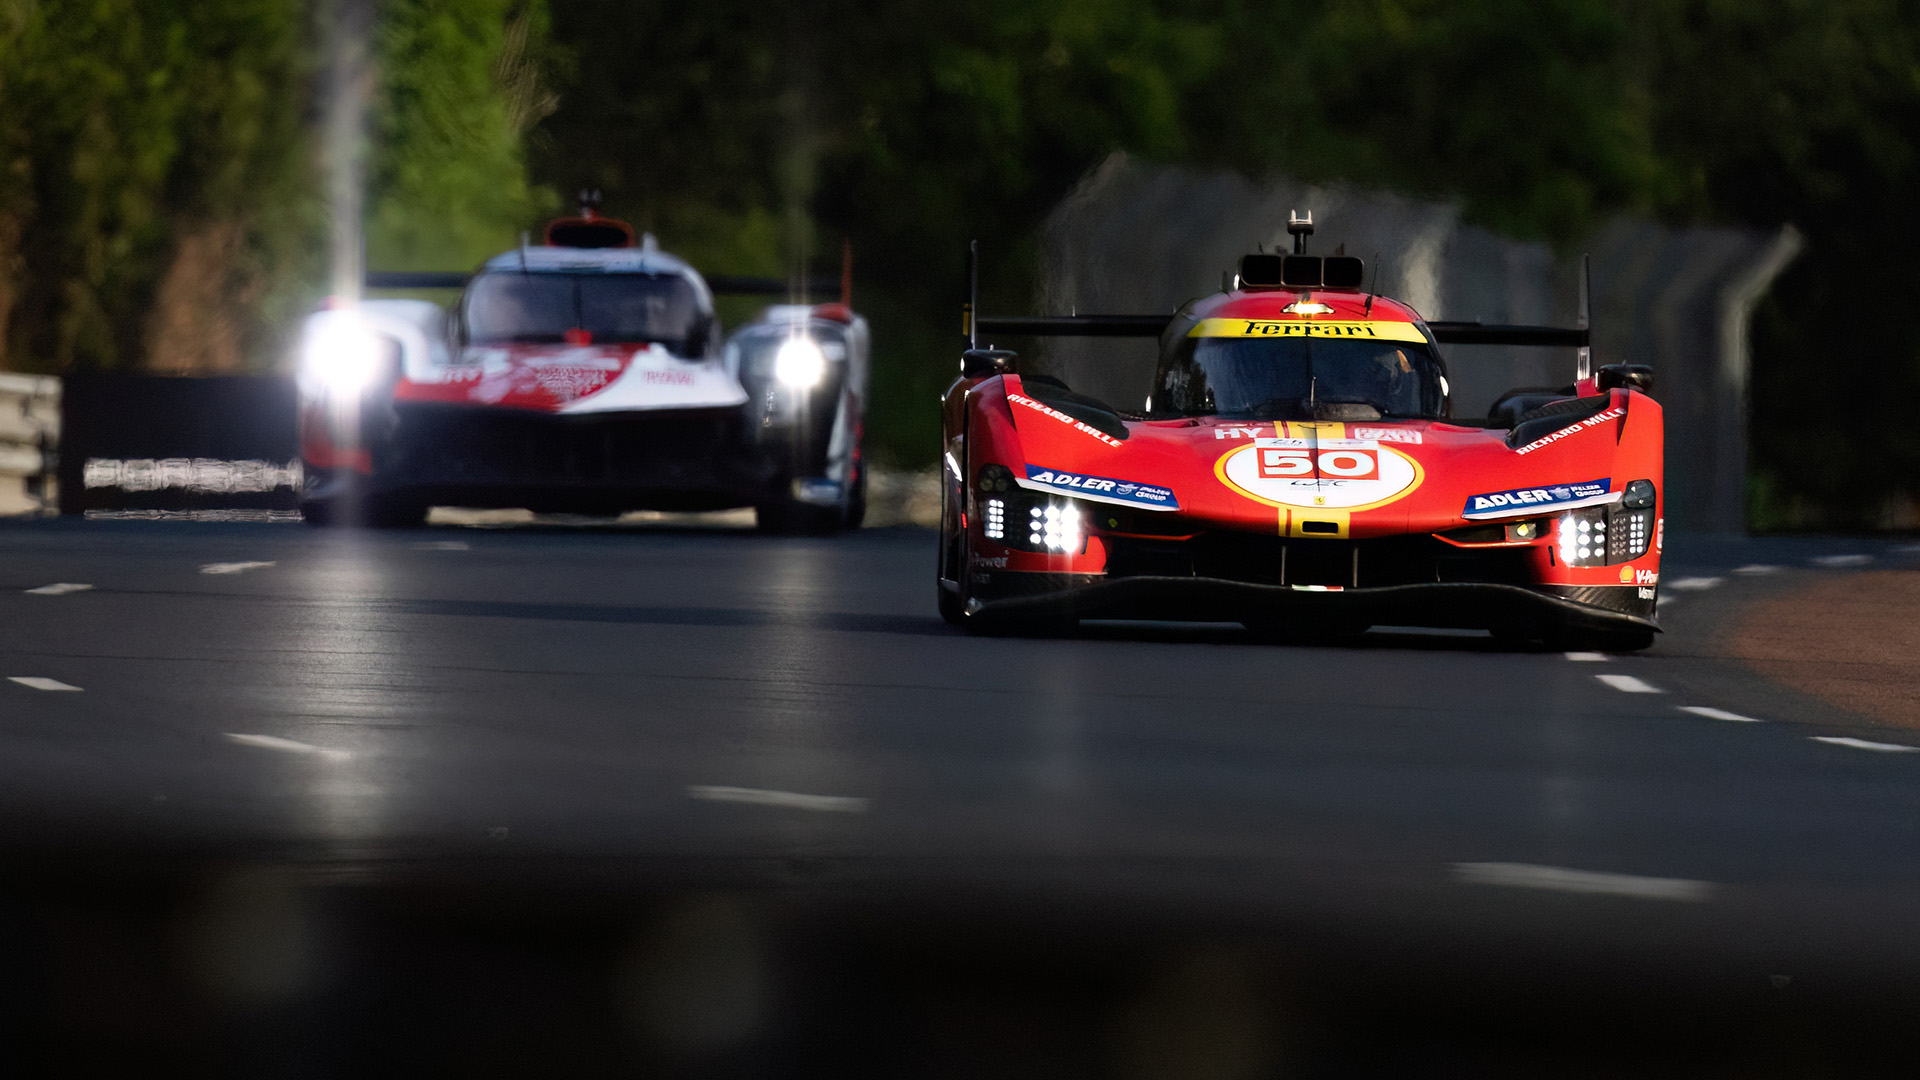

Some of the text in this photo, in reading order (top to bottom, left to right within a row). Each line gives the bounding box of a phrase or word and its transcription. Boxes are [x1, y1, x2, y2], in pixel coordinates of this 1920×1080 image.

[1244, 320, 1376, 337] Ferrari
[1007, 394, 1122, 448] RICHARD MILLE
[1214, 427, 1263, 440] HY
[1515, 424, 1583, 455] RICHARD
[1263, 449, 1375, 477] 50
[1030, 471, 1117, 492] ADLER
[1475, 489, 1553, 510] ADLER
